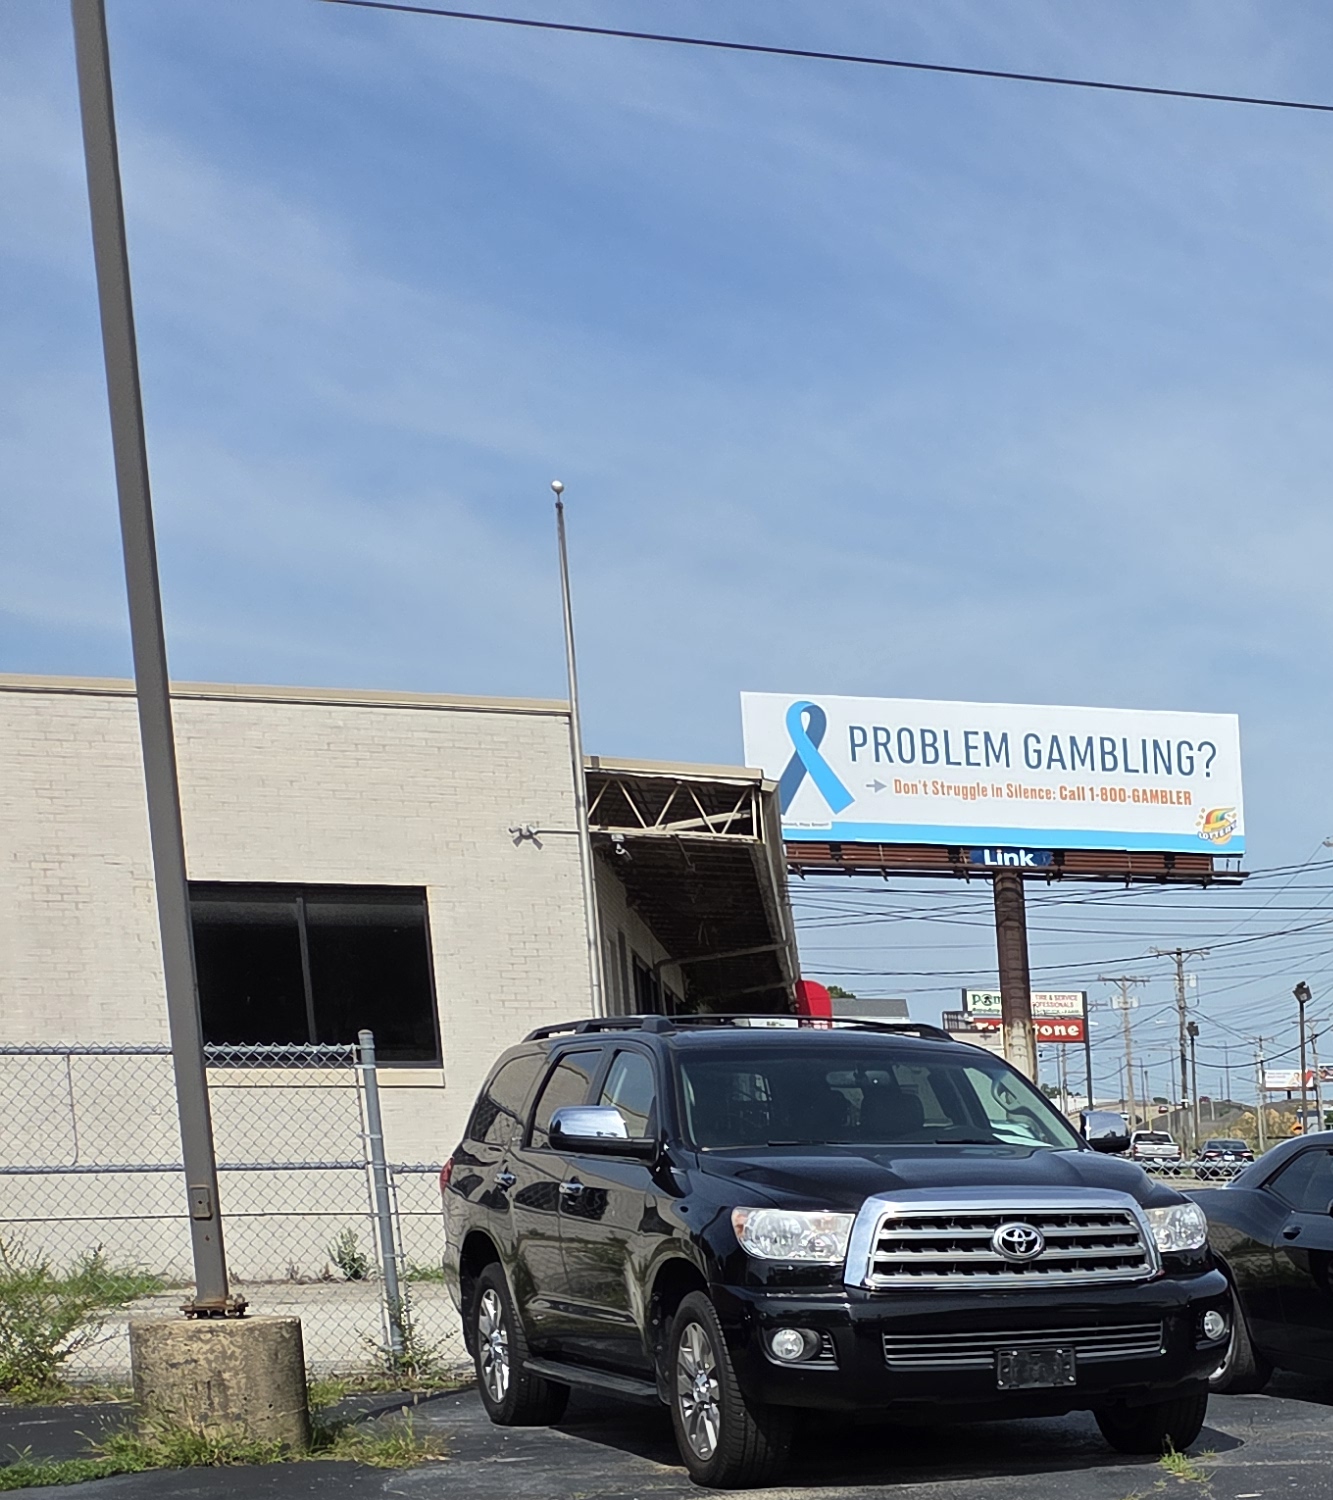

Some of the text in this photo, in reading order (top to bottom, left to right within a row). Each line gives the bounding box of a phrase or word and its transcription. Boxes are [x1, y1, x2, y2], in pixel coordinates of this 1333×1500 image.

[849, 725, 1217, 778] PROBLEM GAMBLING?
[894, 779, 928, 795] Don't
[932, 781, 988, 800] Struggle
[1006, 783, 1056, 800] Silence:
[1059, 785, 1085, 801] Call
[1089, 786, 1192, 806] 1-800-GAMBLER
[1198, 819, 1238, 842] LOTTERY
[983, 849, 1036, 867] Link
